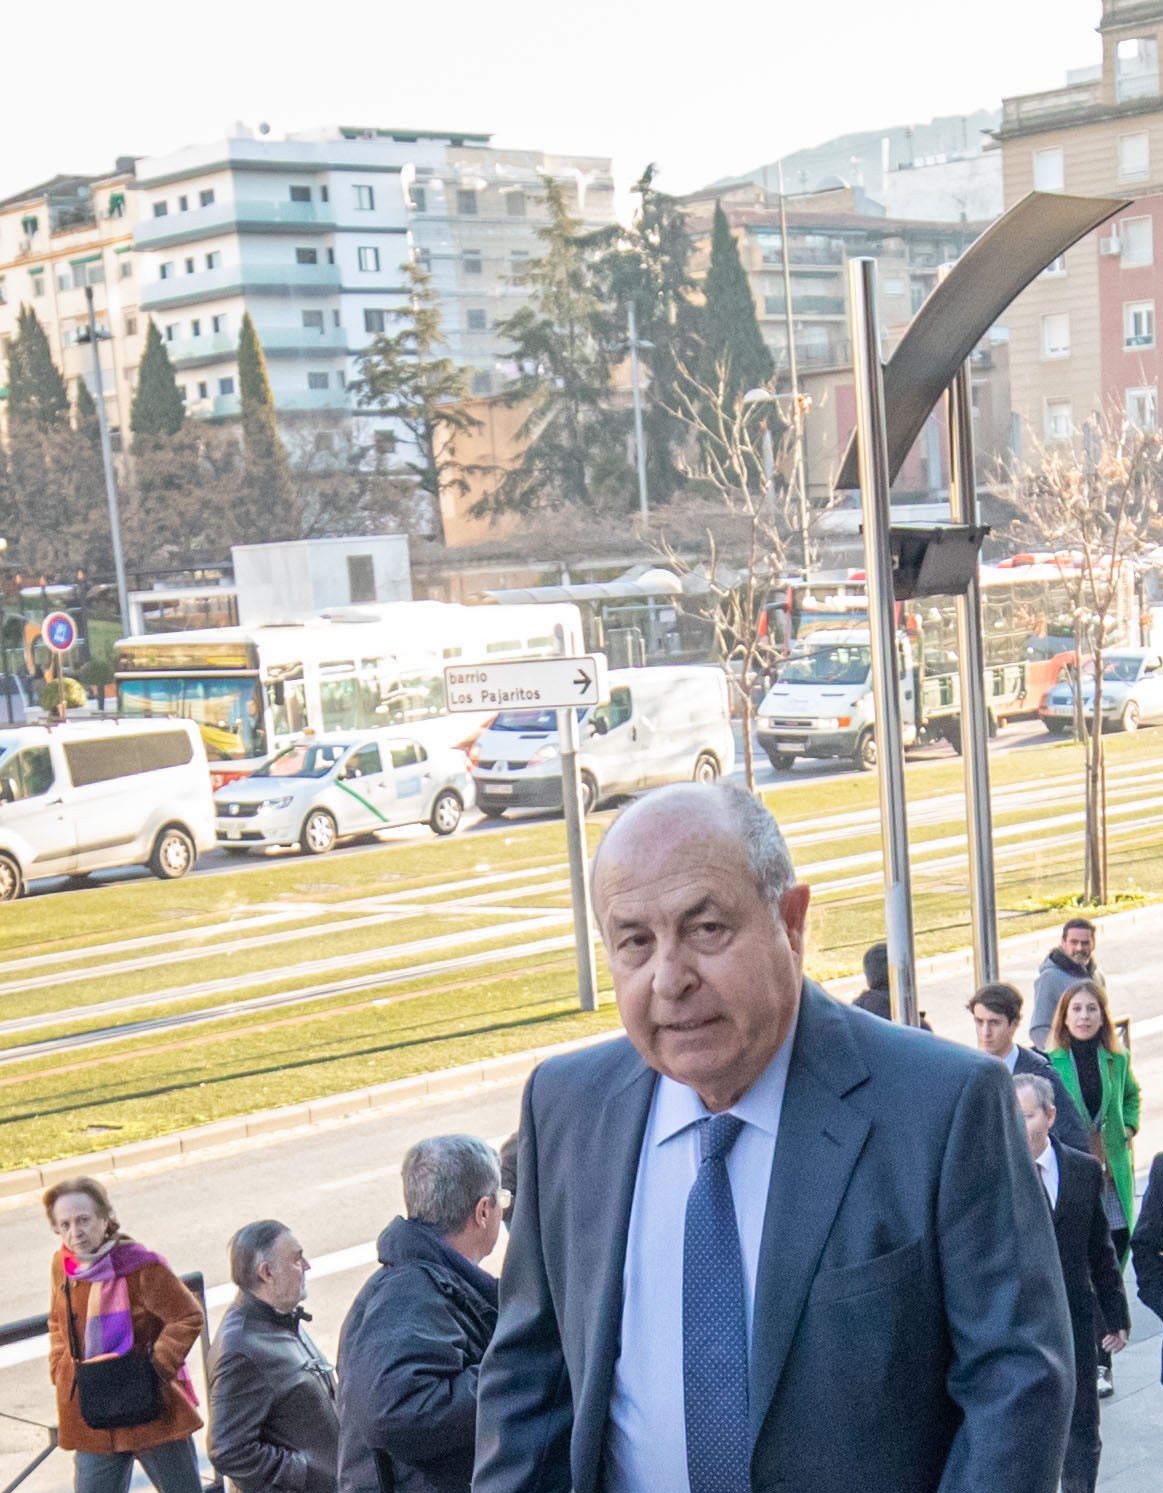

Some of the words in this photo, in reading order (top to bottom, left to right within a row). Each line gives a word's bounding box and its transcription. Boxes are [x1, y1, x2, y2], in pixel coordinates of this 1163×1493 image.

[450, 670, 488, 685] barrio
[450, 691, 473, 705] Los
[481, 687, 541, 704] Pajaritos
